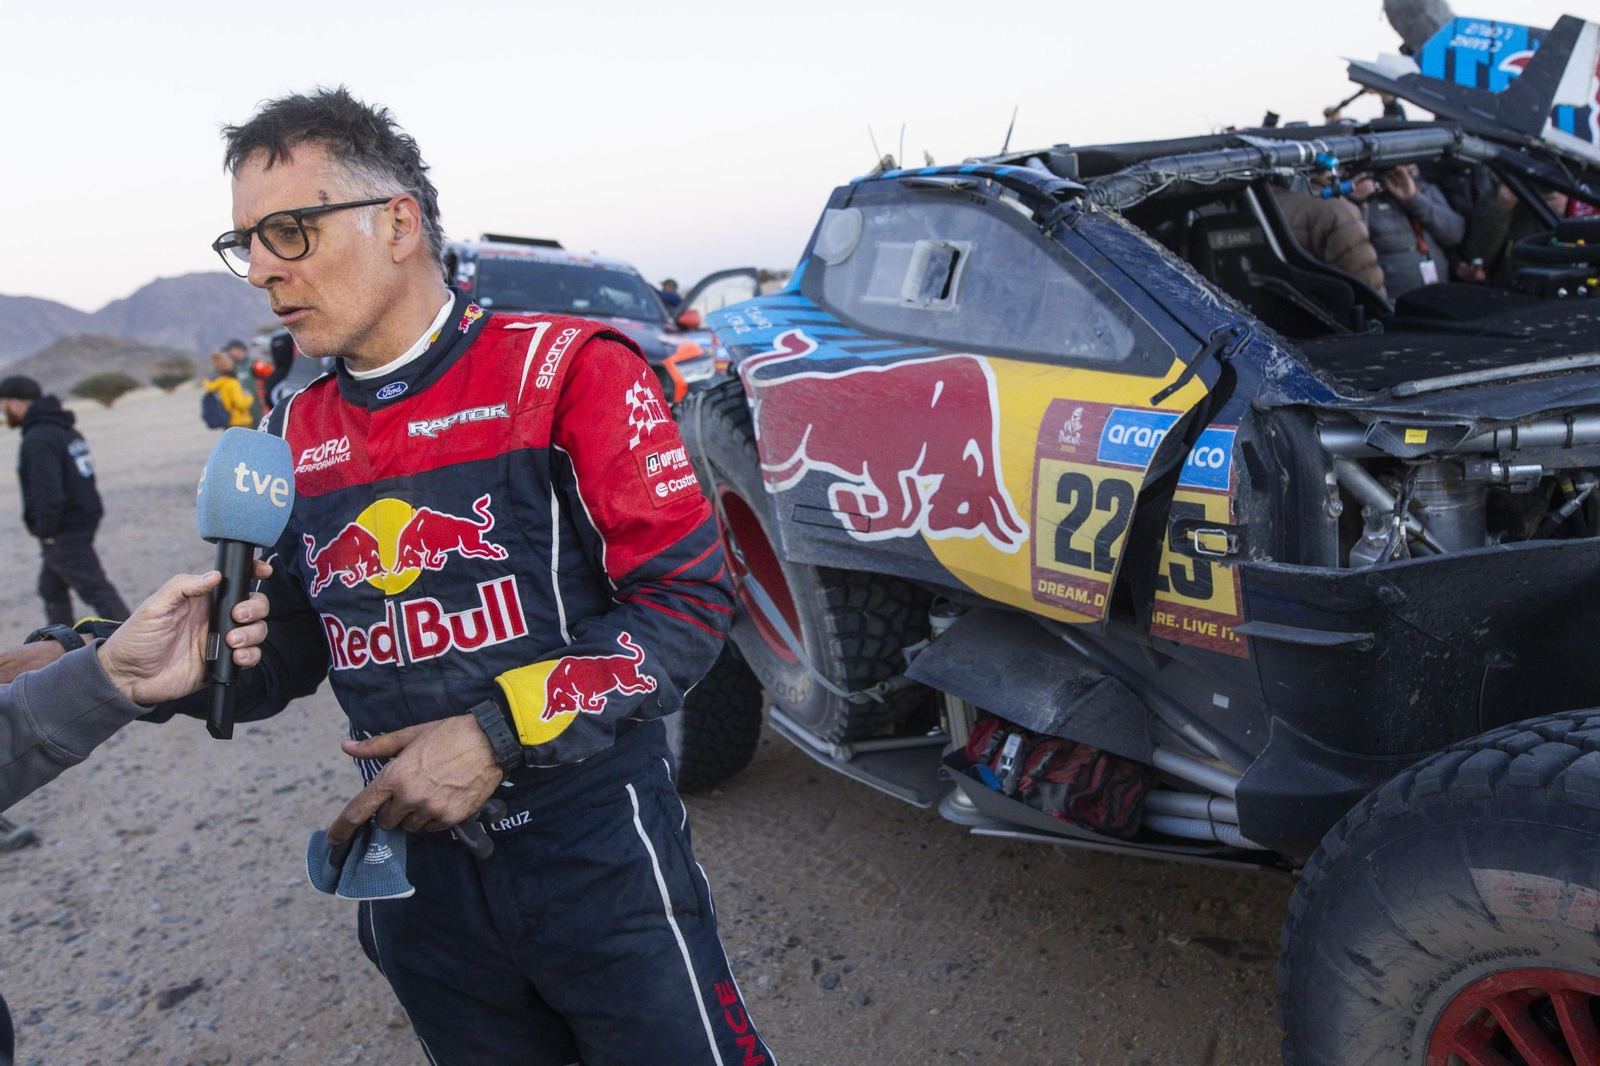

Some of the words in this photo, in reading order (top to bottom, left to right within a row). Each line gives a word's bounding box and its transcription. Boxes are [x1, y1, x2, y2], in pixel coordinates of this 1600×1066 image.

[535, 327, 581, 389] sparco
[382, 384, 403, 398] Ford
[407, 402, 510, 438] RAPTOR
[294, 451, 352, 475] PERFORMANCE
[298, 434, 351, 466] FORD
[234, 462, 289, 508] tve
[320, 599, 405, 671] Red
[400, 574, 530, 664] Bull
[1037, 579, 1092, 604] DREAM.
[1182, 617, 1218, 637] LIVE
